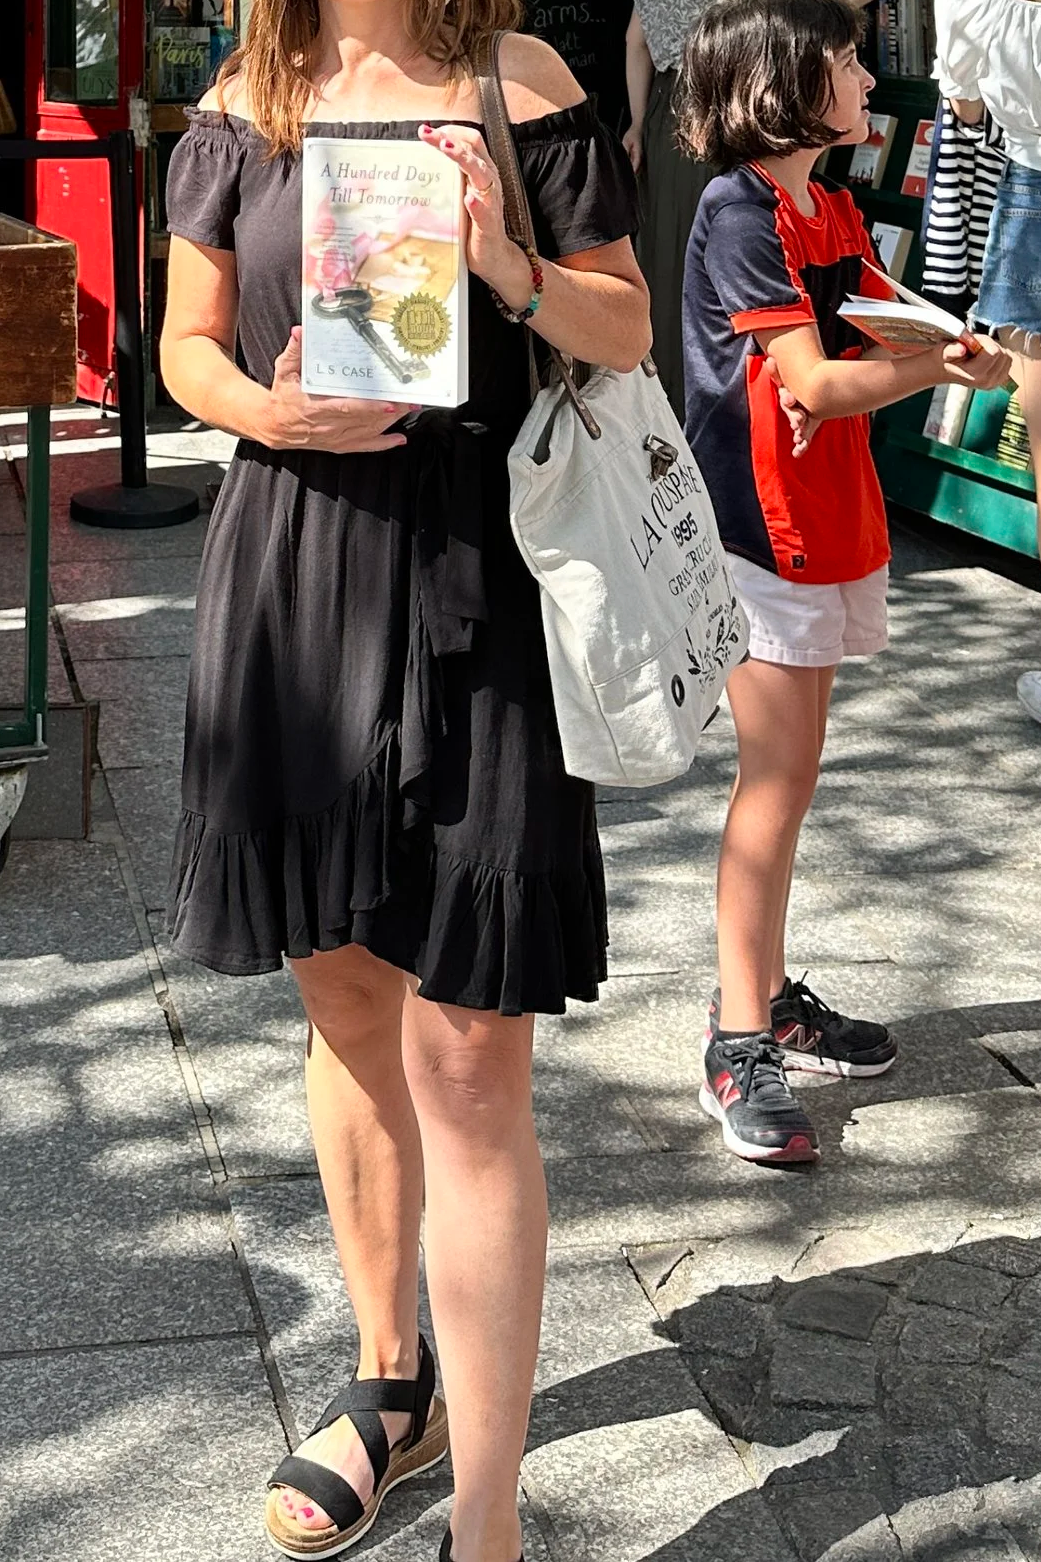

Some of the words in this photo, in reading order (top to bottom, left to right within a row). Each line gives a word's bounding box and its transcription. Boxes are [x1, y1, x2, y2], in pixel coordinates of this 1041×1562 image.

[533, 2, 607, 28] arms...
[156, 34, 205, 68] Paris
[554, 31, 583, 53] alt
[320, 163, 332, 178] A
[338, 162, 399, 181] Hundred
[405, 164, 441, 188] Days
[330, 187, 352, 204] Till
[358, 188, 432, 208] Tomorrow
[341, 366, 374, 379] CASE
[671, 511, 698, 550] 1995
